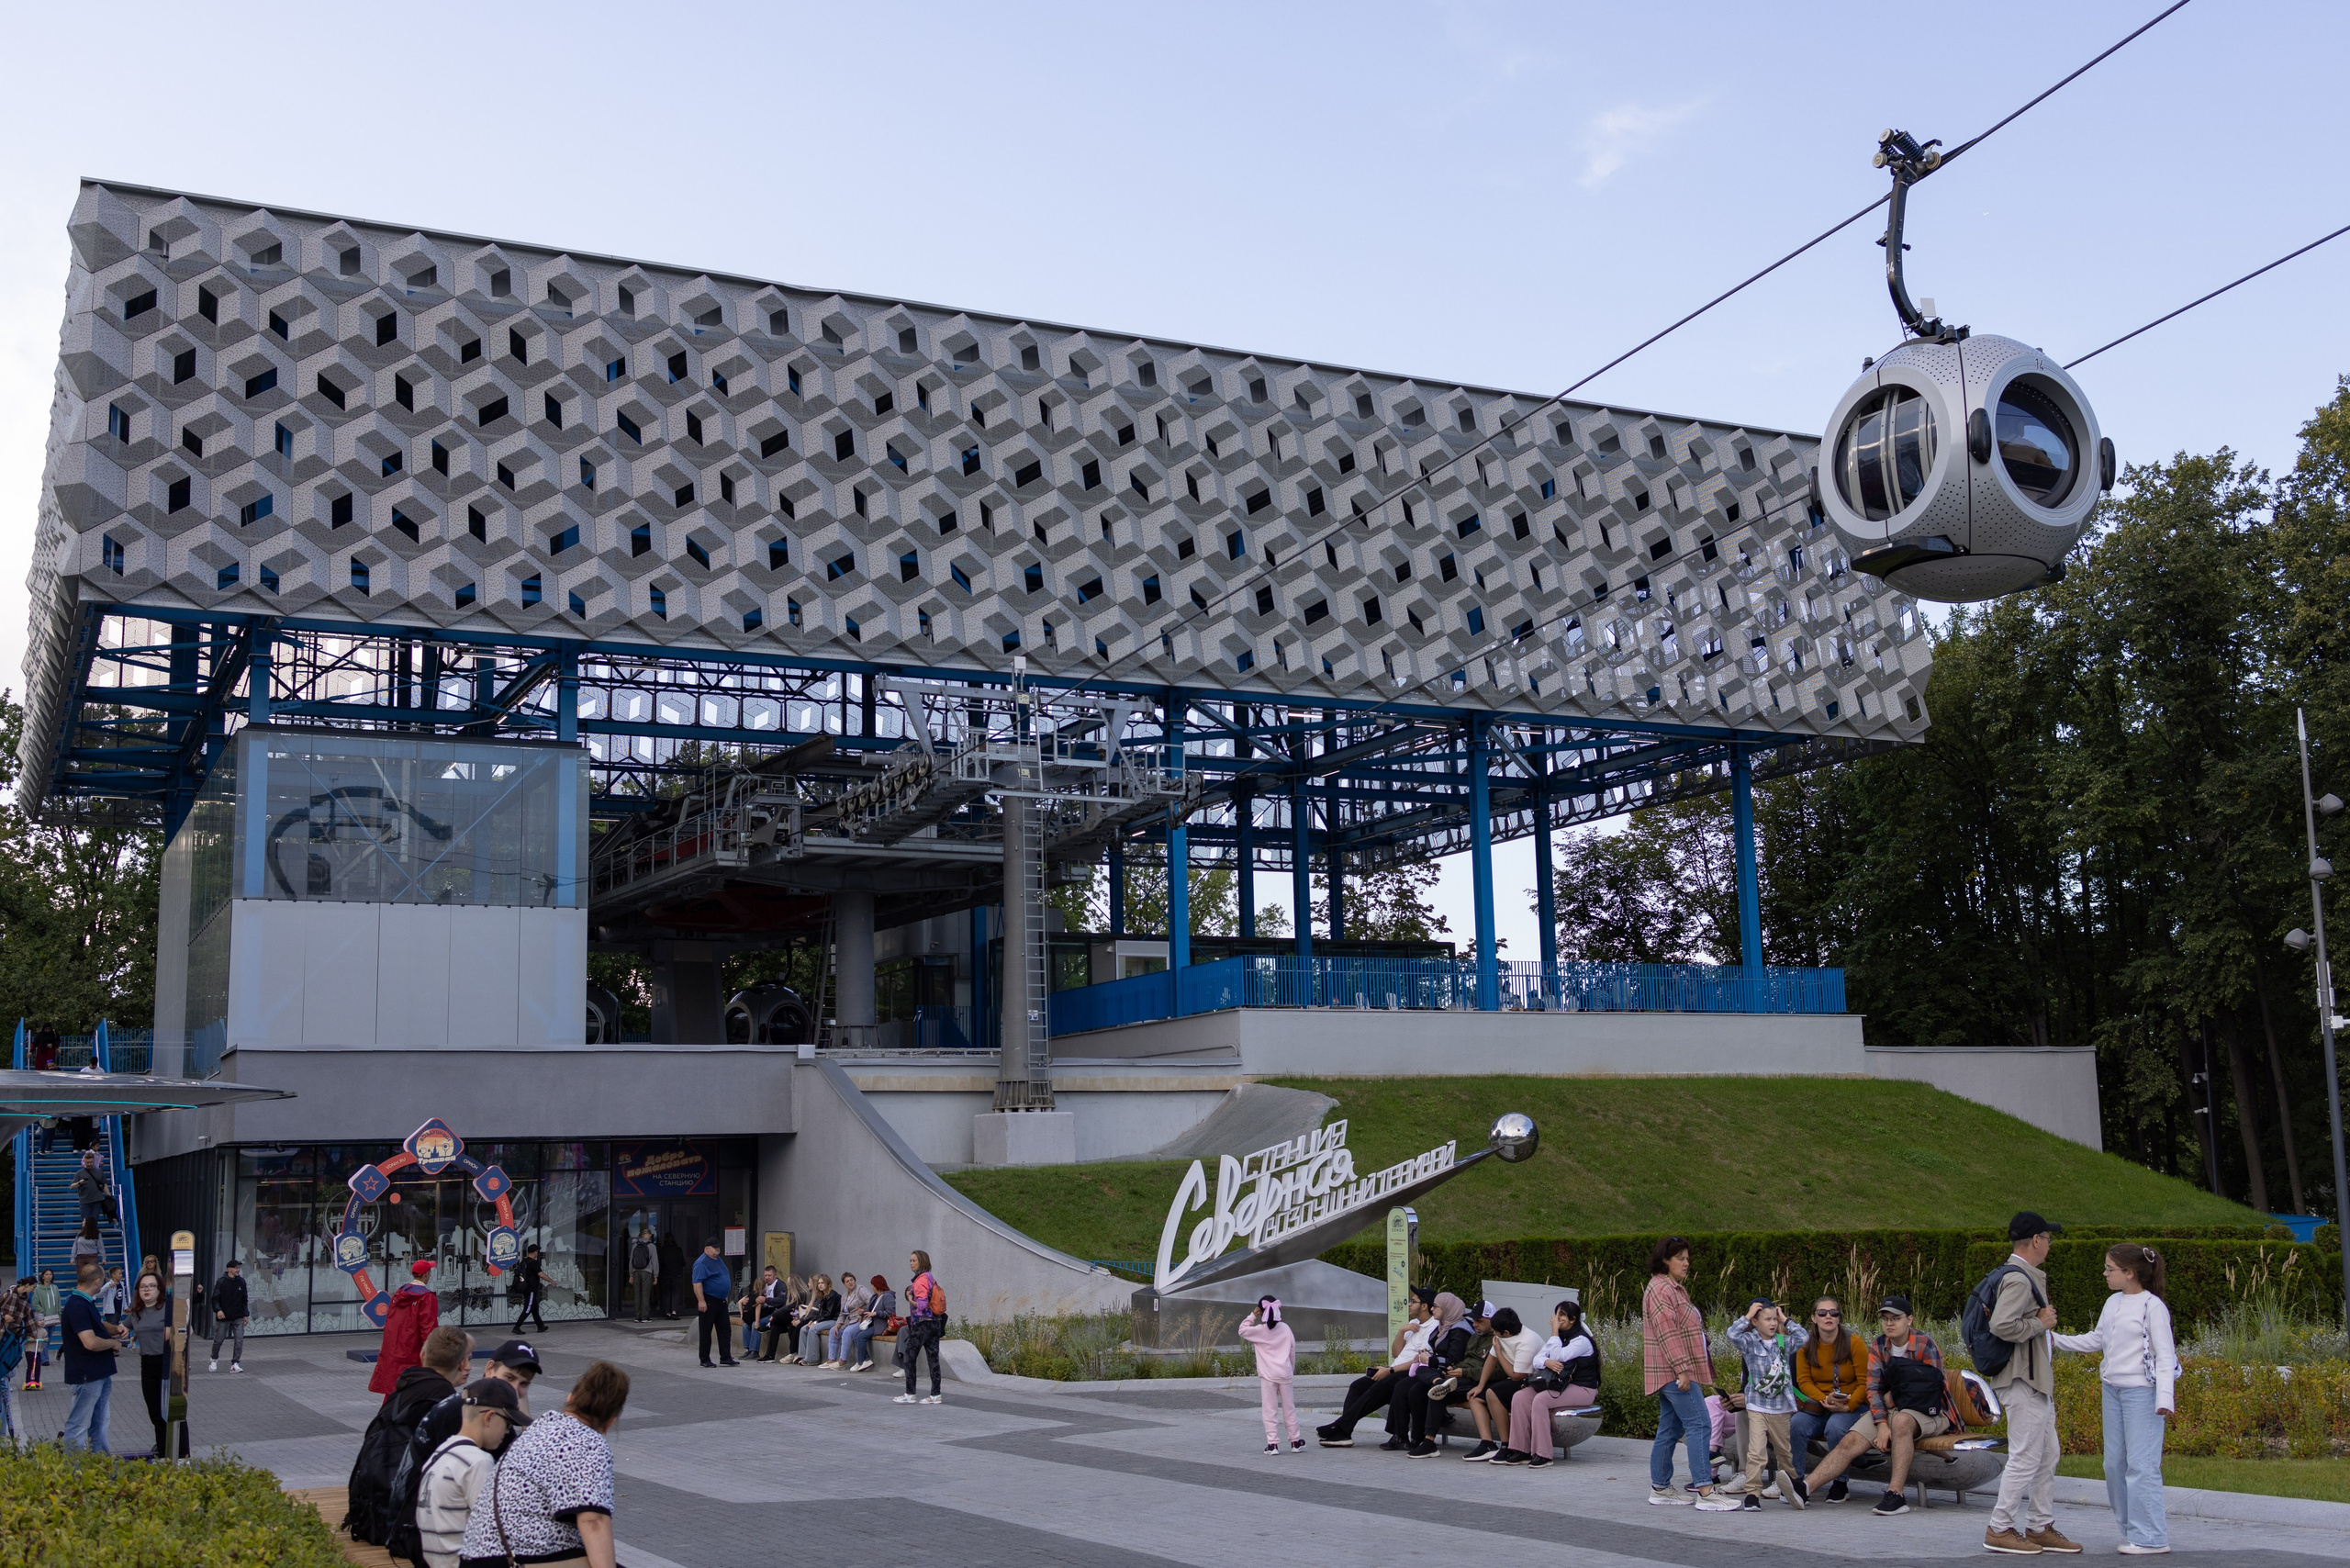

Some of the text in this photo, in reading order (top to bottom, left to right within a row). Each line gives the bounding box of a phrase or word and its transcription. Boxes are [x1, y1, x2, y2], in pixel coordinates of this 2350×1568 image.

[2035, 358, 2044, 371] 14
[420, 1129, 453, 1142] ВОЗДУШНЫЙ
[645, 1150, 685, 1167] Добро
[1241, 1118, 1348, 1182] СТАНЦИЯ
[386, 1157, 407, 1170] VDNH.RU
[463, 1159, 479, 1170] ОРИОН
[626, 1155, 702, 1178] пожаловать
[1262, 1139, 1457, 1243] ВОЗДУШНЫЙ ТРАМВАЙ
[350, 1200, 360, 1219] ОРИОН
[501, 1199, 509, 1220] VDNH.RU
[1154, 1148, 1359, 1295] Северная
[359, 1275, 372, 1294] VDNH.RU
